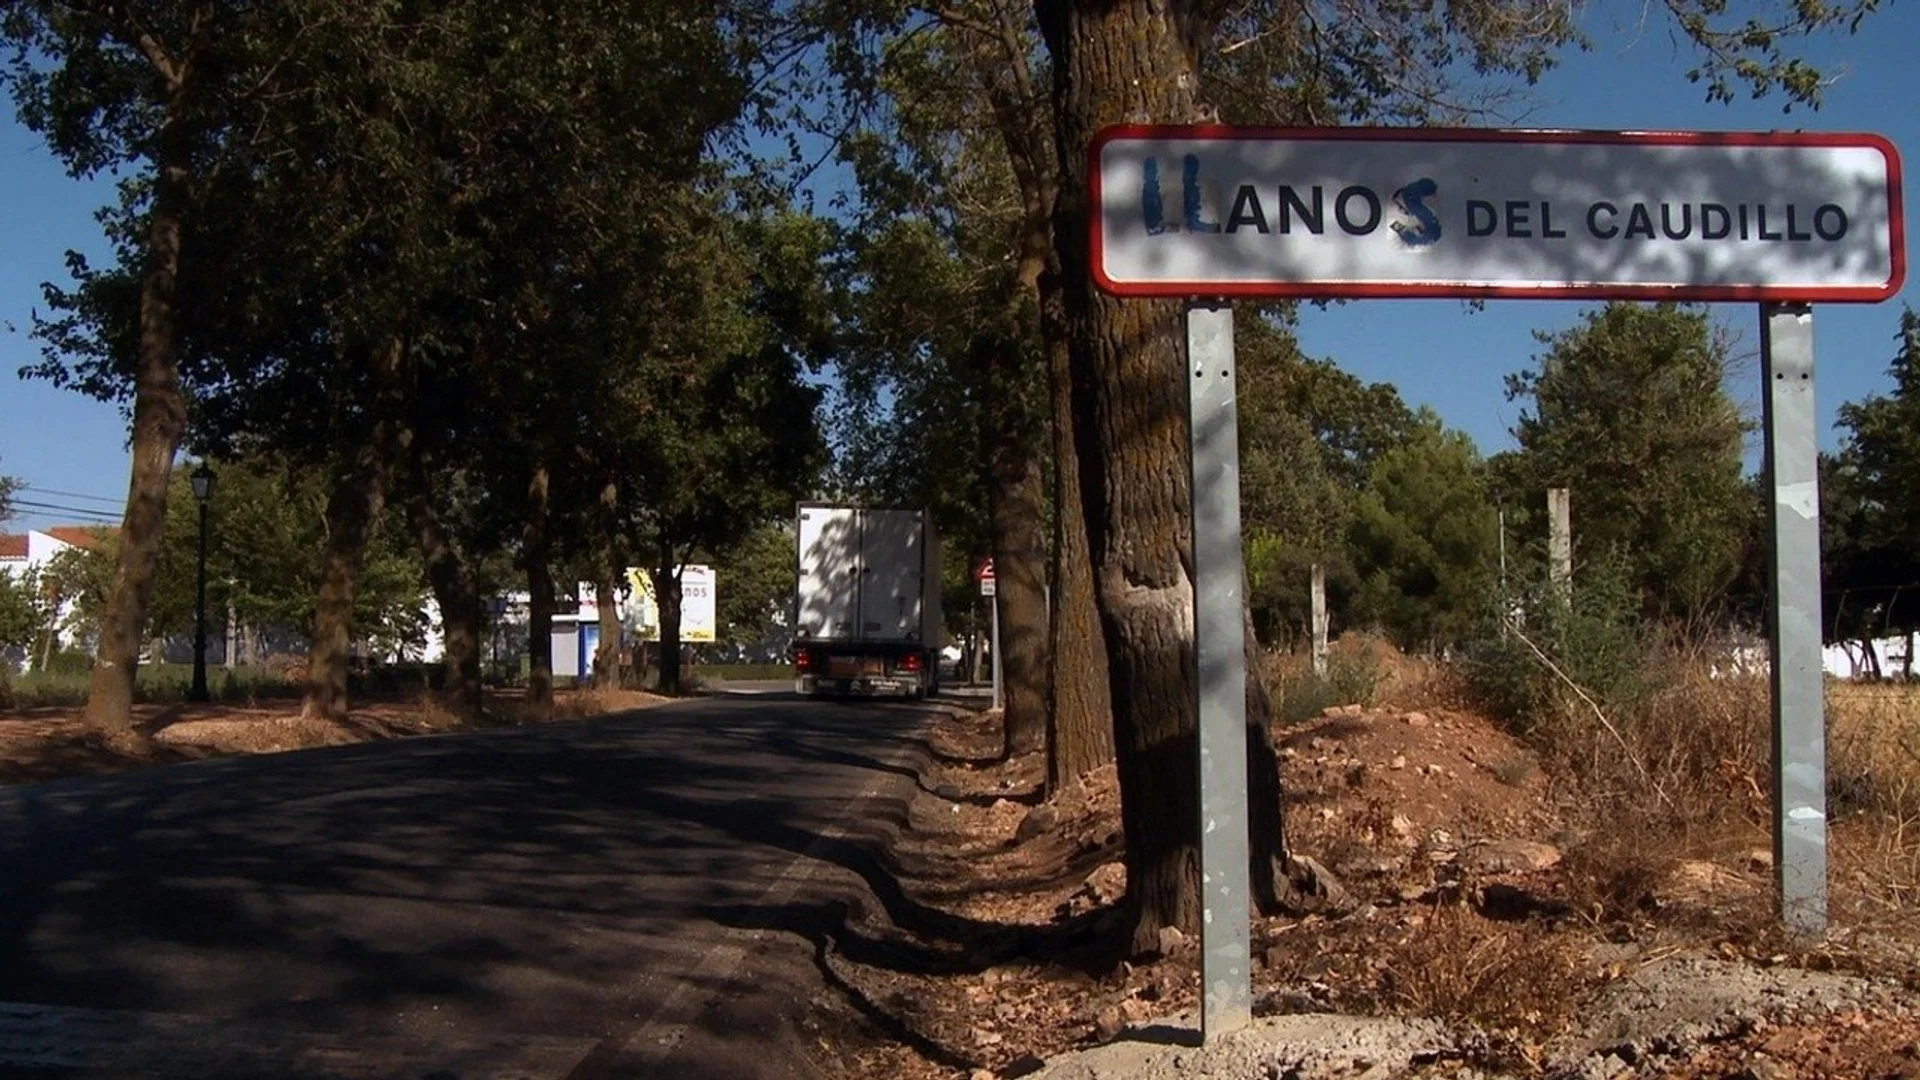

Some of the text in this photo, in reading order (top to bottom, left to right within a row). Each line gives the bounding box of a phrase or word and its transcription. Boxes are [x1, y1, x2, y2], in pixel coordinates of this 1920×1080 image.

[1142, 153, 1849, 248] LLANOS DEL CAUDILLO
